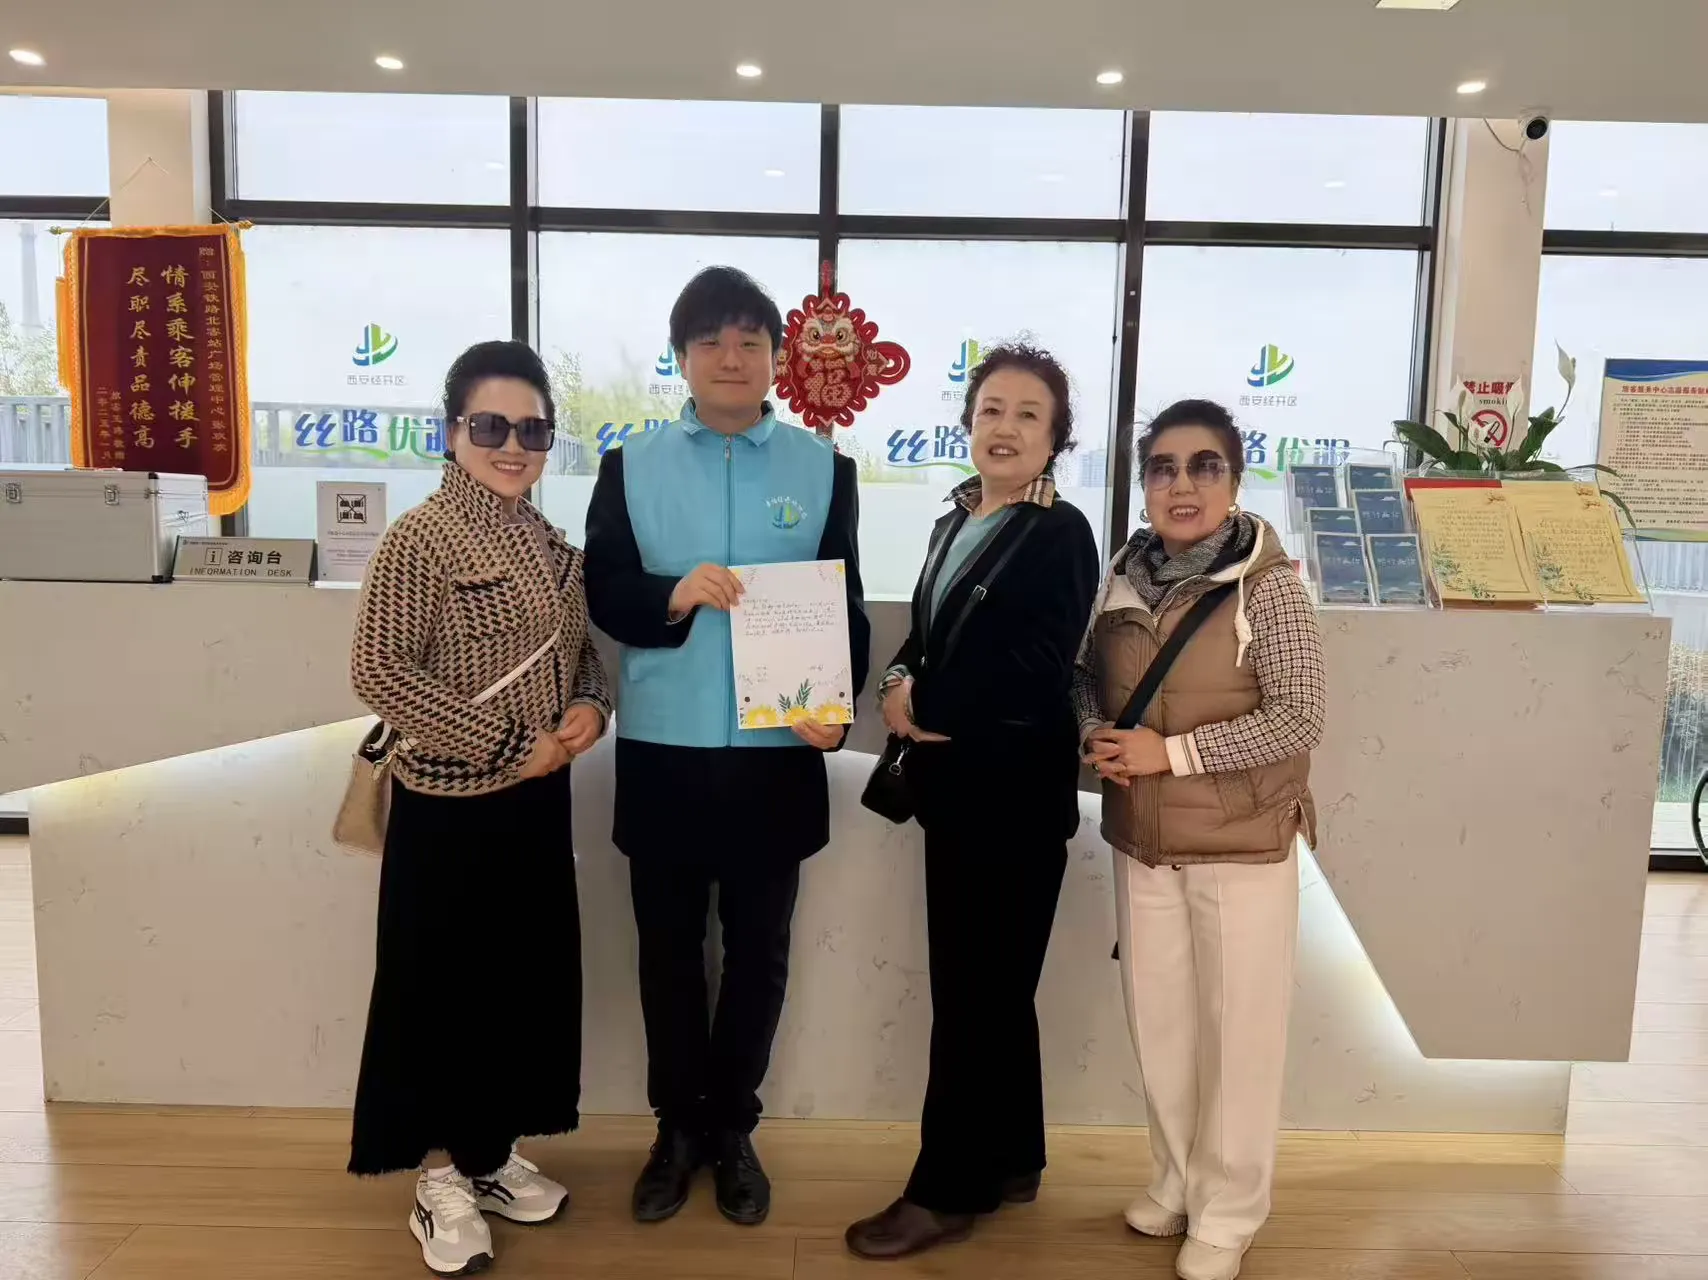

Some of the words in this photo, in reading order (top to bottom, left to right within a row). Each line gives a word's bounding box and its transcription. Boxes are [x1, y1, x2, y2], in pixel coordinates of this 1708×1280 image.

[127, 267, 155, 448] 尽职尽责品德高
[161, 265, 199, 448] 情系乘客伸援手
[346, 375, 406, 385] 西安经开区
[649, 383, 688, 395] 西安经
[1239, 396, 1297, 406] 西安经开区
[227, 550, 282, 565] 咨询台
[189, 567, 257, 576] INFORMATION
[267, 568, 292, 577] DESK
